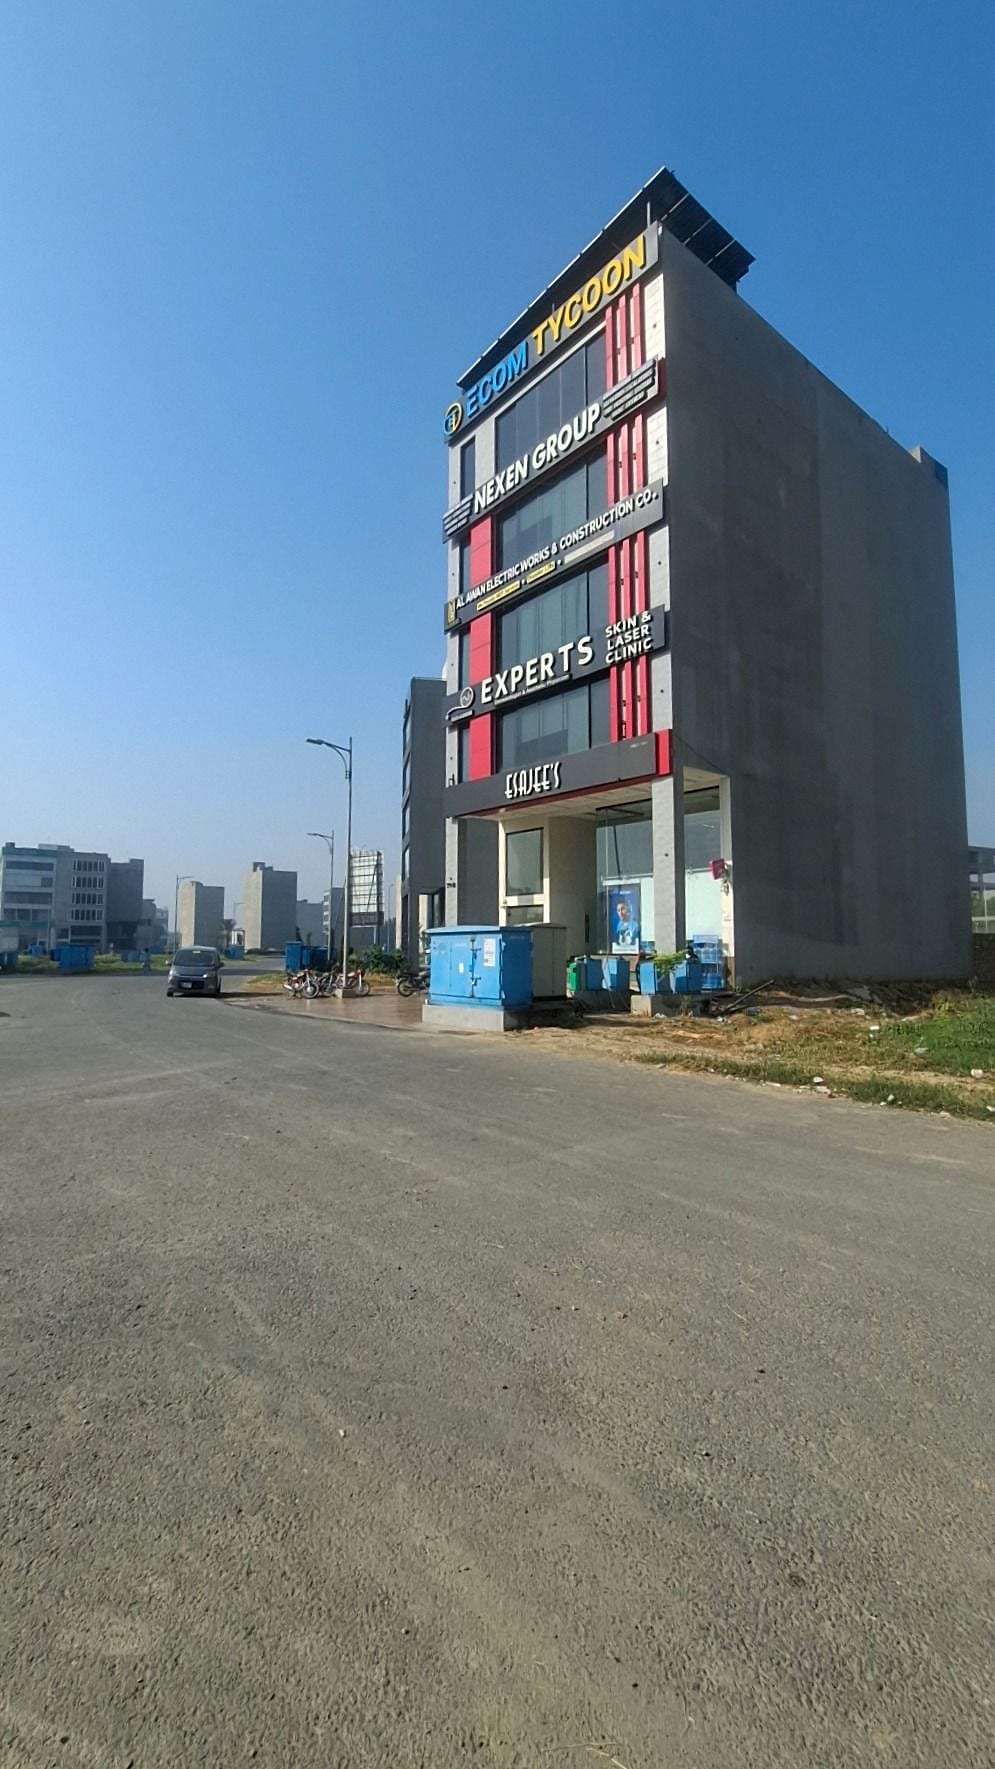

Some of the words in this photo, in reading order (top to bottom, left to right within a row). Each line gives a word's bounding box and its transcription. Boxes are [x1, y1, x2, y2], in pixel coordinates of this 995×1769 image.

[466, 341, 528, 417] ECOM
[533, 233, 645, 356] TYCOON
[474, 454, 528, 514] NEXEN
[532, 402, 600, 469] GROUP
[456, 594, 465, 610] AL
[465, 586, 486, 604] AWAN
[486, 564, 520, 592] ELECTRIC
[520, 547, 550, 572] WORKS
[551, 542, 558, 555] &
[559, 500, 633, 549] CONSTRUCTION
[635, 488, 659, 508] CO.
[605, 615, 637, 638] SKIN
[641, 610, 651, 623] &
[605, 637, 651, 664] CLINIC
[607, 624, 649, 651] LASER
[481, 636, 593, 704] EXPERTS
[505, 761, 562, 799] ESAJEE'S
